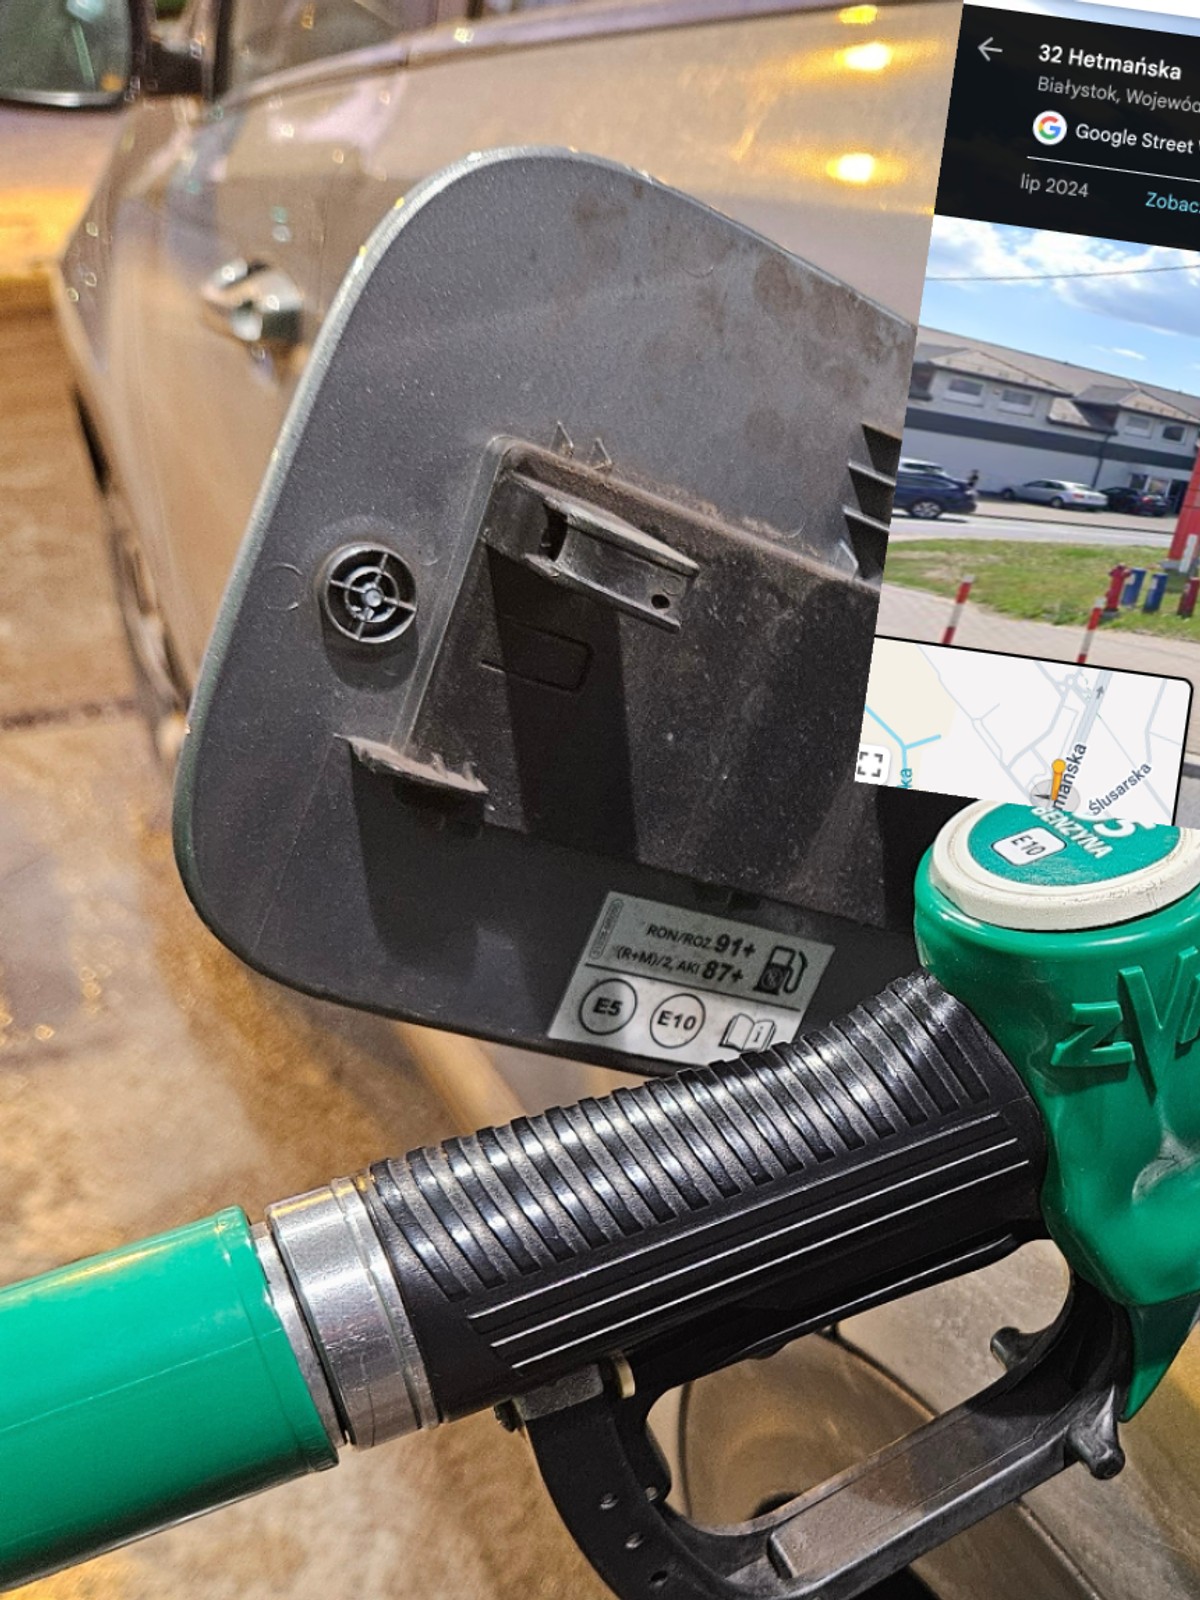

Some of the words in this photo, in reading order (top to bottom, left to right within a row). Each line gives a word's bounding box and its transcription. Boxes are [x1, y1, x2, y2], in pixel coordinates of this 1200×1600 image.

[715, 933, 756, 958] 91+
[702, 959, 743, 984] 87+
[593, 997, 623, 1017] E5
[657, 1011, 697, 1031] E10
